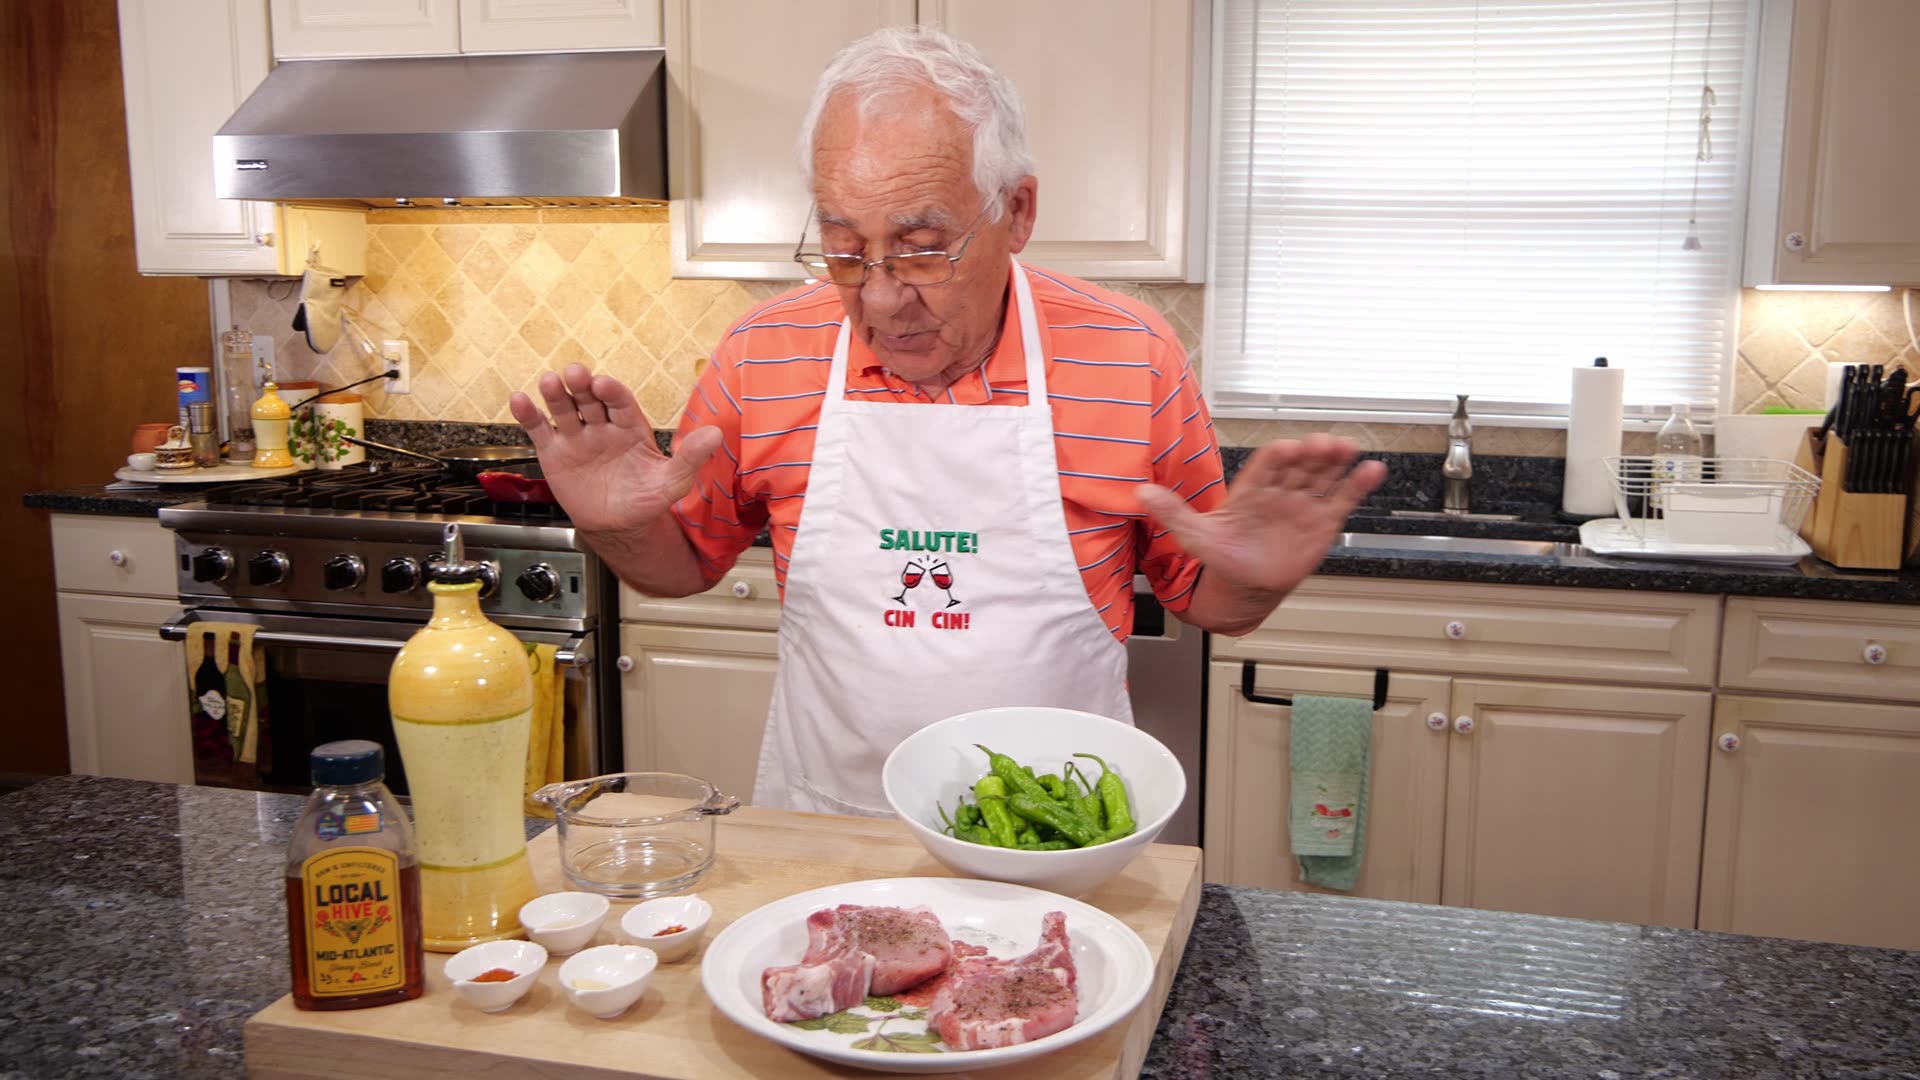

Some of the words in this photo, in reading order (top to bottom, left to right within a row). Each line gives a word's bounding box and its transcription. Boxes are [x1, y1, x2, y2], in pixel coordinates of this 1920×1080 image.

[879, 528, 978, 554] SALUTE!
[883, 609, 915, 628] CIN
[931, 611, 970, 630] CIN!
[316, 880, 388, 906] LOCAL
[332, 902, 374, 920] HIVE
[316, 944, 394, 961] MID-ATLANTIC
